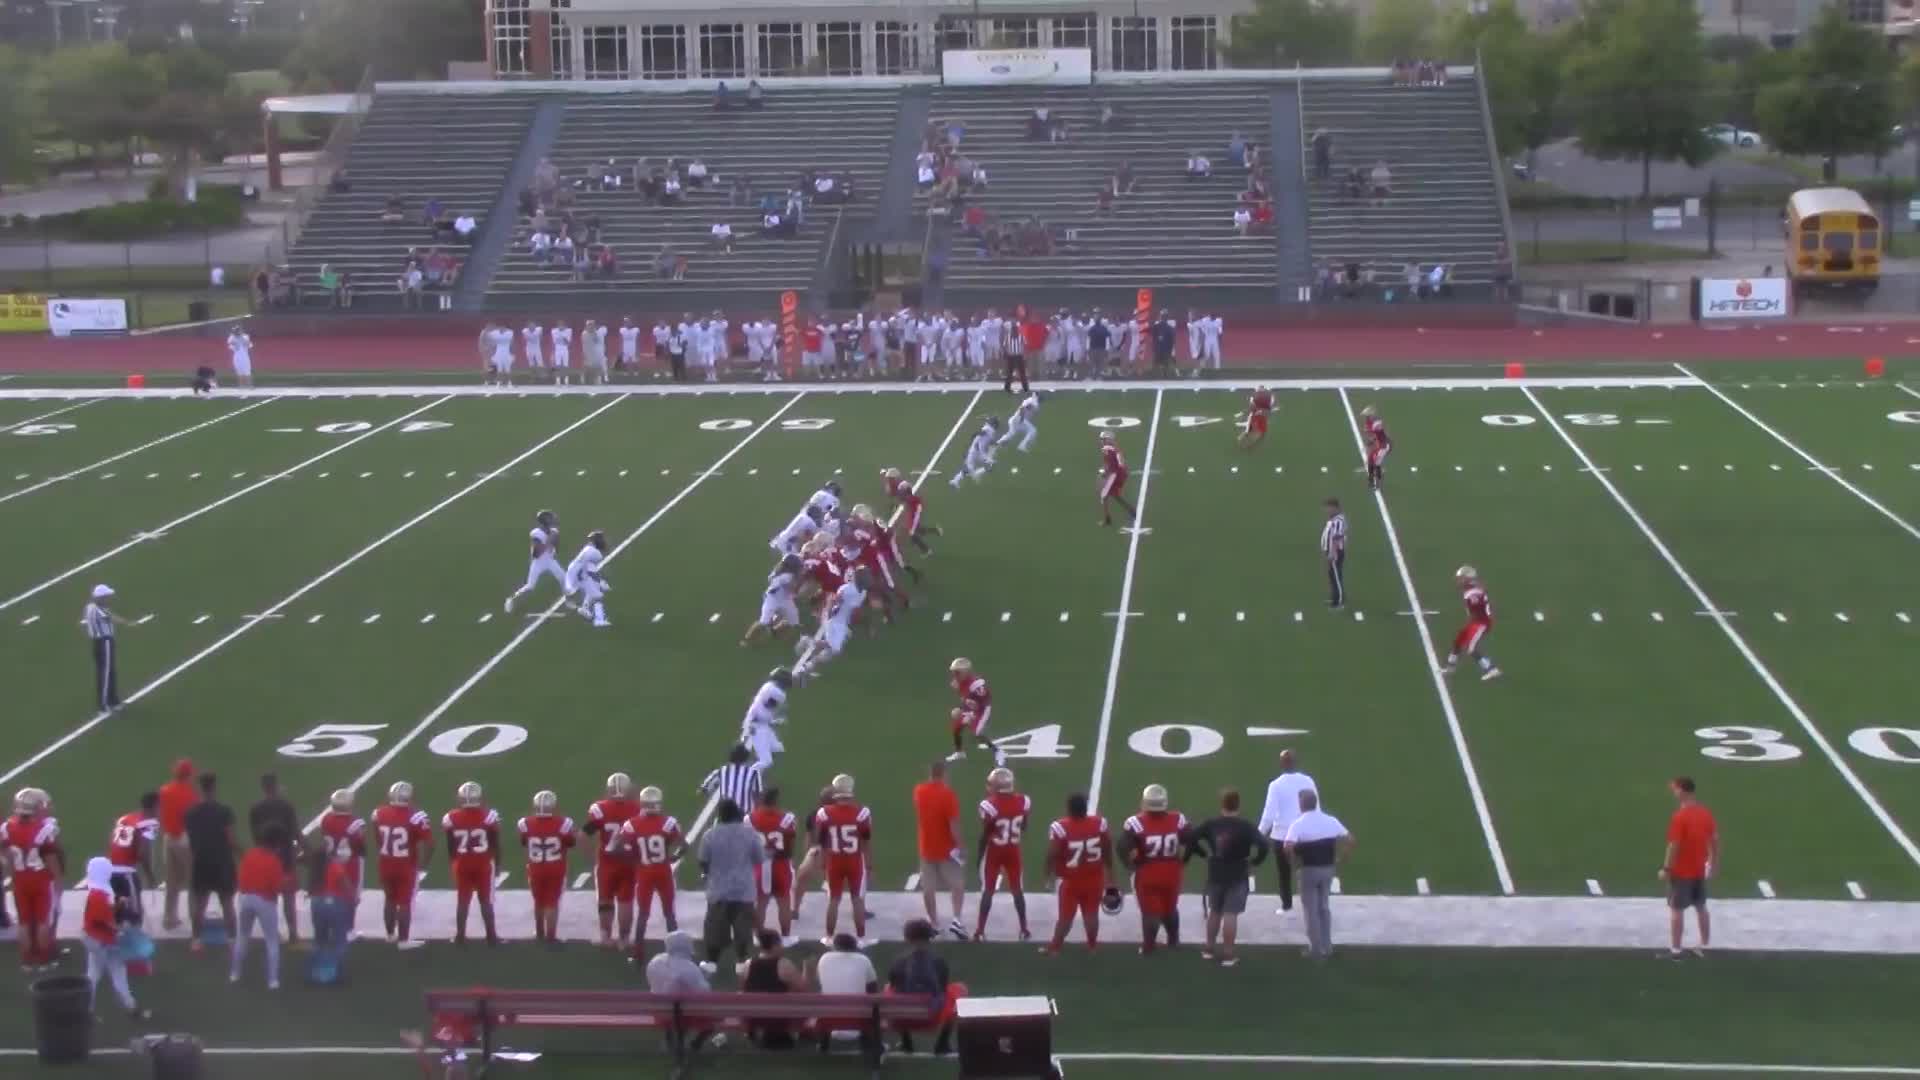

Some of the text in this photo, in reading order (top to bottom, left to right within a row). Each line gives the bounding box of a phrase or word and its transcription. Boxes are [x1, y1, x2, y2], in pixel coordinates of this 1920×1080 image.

[379, 826, 409, 857] 72
[453, 828, 489, 854] 73
[528, 836, 562, 862] 62
[637, 835, 666, 865] 19
[829, 824, 859, 853] 15
[1065, 836, 1102, 868] 75
[1145, 833, 1178, 858] 70
